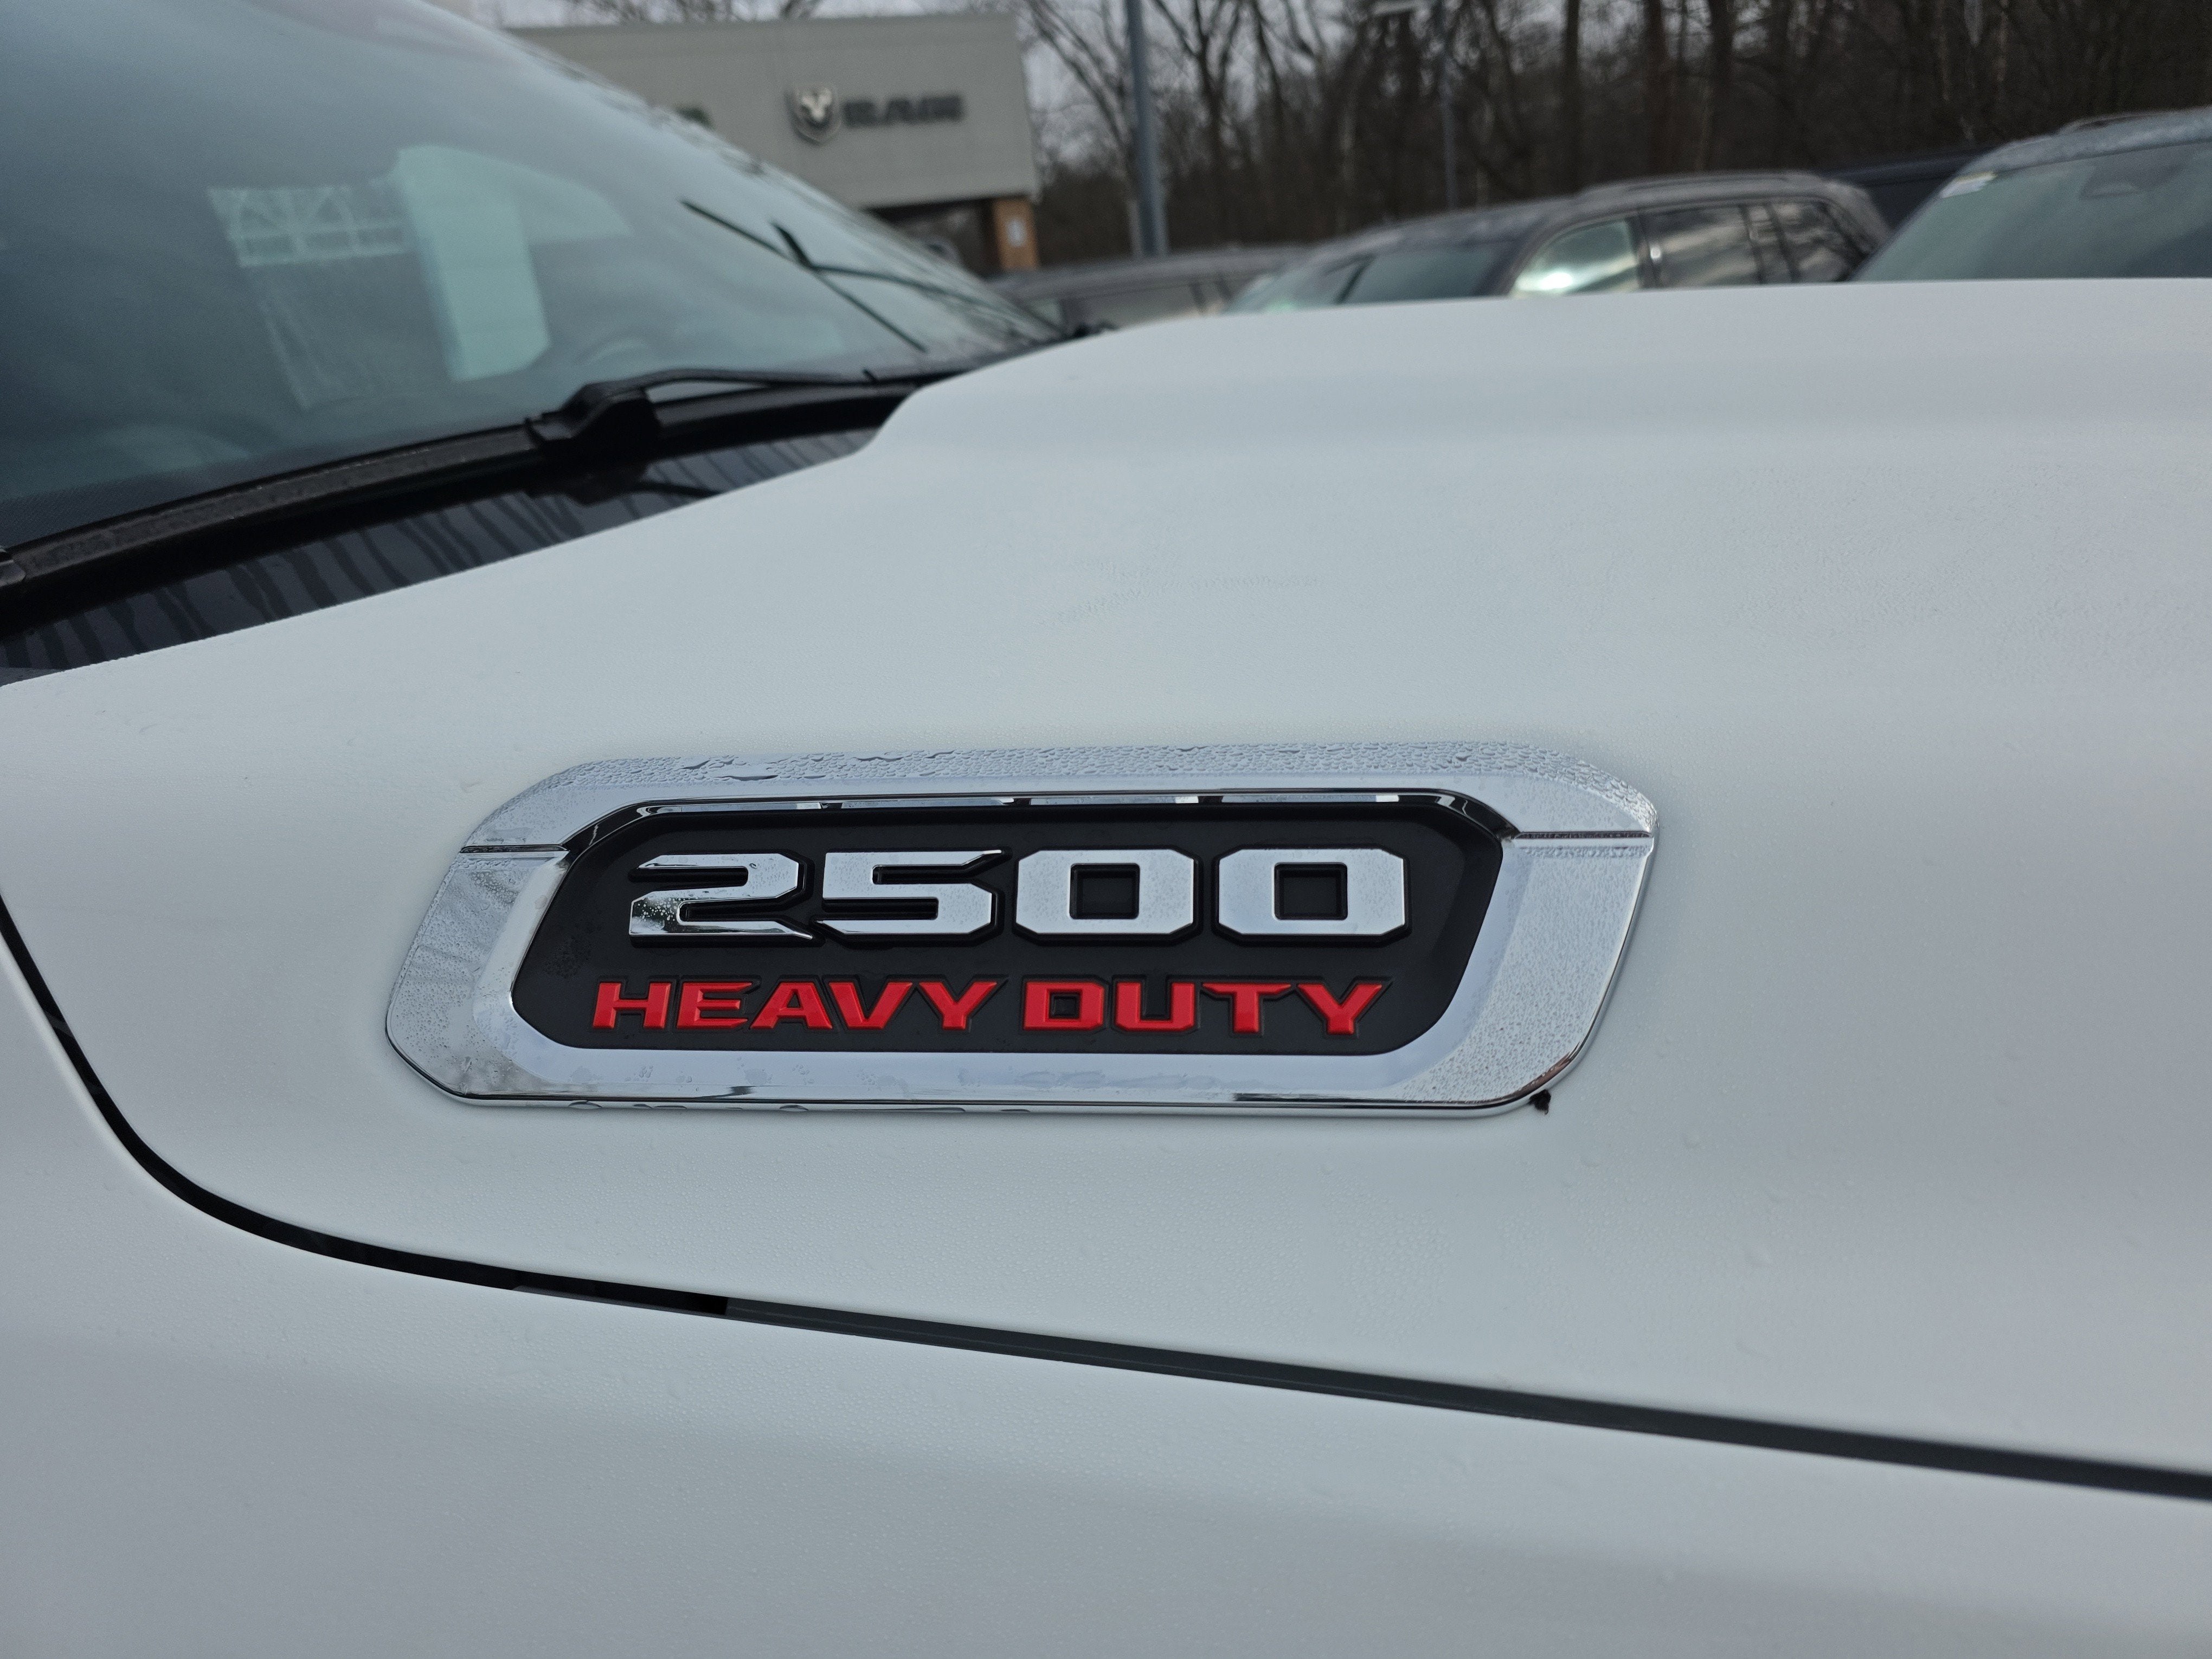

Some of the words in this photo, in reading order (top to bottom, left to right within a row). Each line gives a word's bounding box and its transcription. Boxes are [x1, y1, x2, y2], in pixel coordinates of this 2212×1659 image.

[629, 848, 1406, 938] 2500
[592, 981, 999, 1030] HEAVY
[1023, 981, 1384, 1034] DUTY
